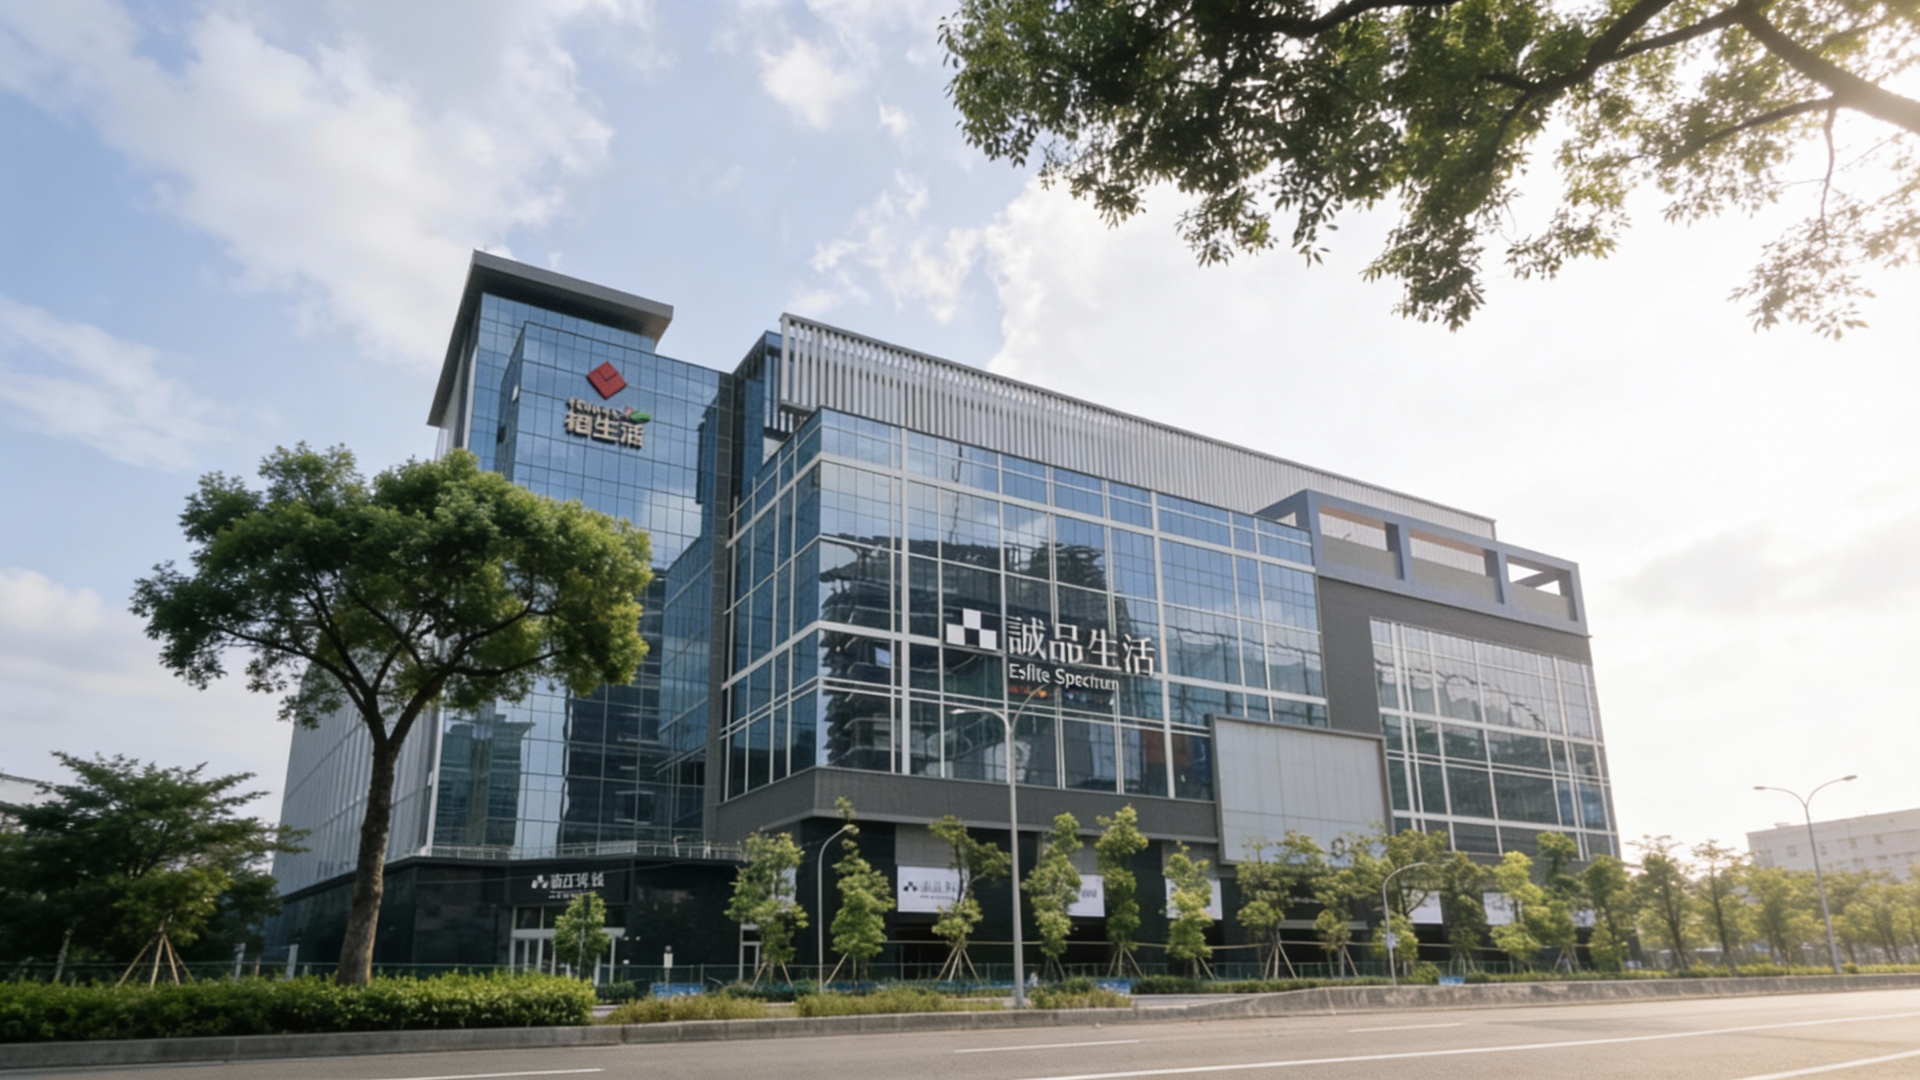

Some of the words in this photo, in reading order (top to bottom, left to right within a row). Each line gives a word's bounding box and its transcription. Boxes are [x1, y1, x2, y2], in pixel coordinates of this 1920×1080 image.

[1006, 616, 1156, 677] 誠品生活
[1054, 668, 1119, 690] Spectrum
